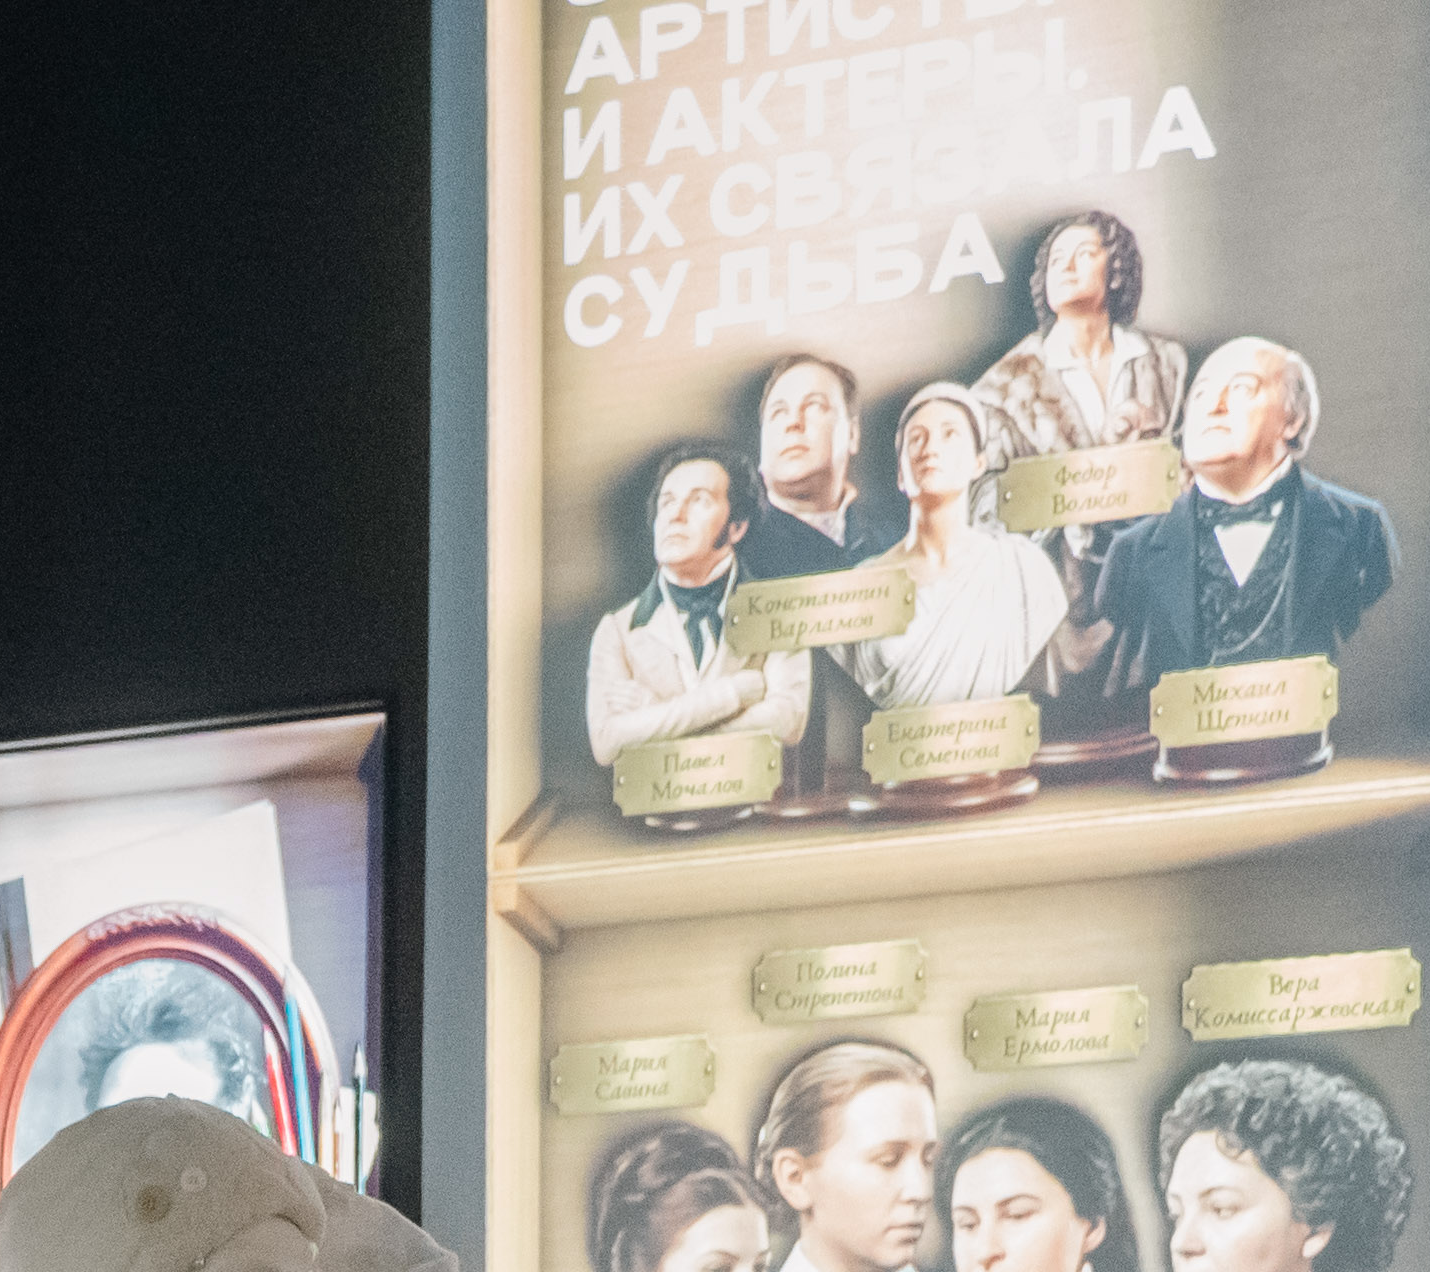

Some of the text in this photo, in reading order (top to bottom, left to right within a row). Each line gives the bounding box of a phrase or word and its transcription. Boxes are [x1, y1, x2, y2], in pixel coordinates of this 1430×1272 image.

[562, 17, 1087, 181] И АКТЕРЫ.
[562, 86, 1217, 266] ИХ СВЯЗАЛА
[563, 212, 1005, 348] СУДЬБА
[1054, 463, 1118, 491] Федор
[1052, 491, 1129, 516] Волков
[747, 584, 892, 617] Константин
[769, 613, 875, 644] Варламов
[1193, 679, 1287, 708] Михаил
[888, 715, 1007, 743] Екатерина
[1196, 707, 1290, 733] Щепкин
[663, 752, 726, 775] Павел
[899, 743, 1001, 770] Семенова
[651, 776, 744, 802] Мочалов
[796, 960, 879, 984] Полина
[774, 984, 905, 1017] Стрепетова
[1269, 973, 1321, 1005] Вера
[1015, 1005, 1091, 1034] Мария
[1194, 998, 1408, 1031] Комиссаржевская
[1003, 1032, 1110, 1064] Ермолова
[598, 1053, 670, 1080] Мария
[595, 1079, 670, 1101] Савина
